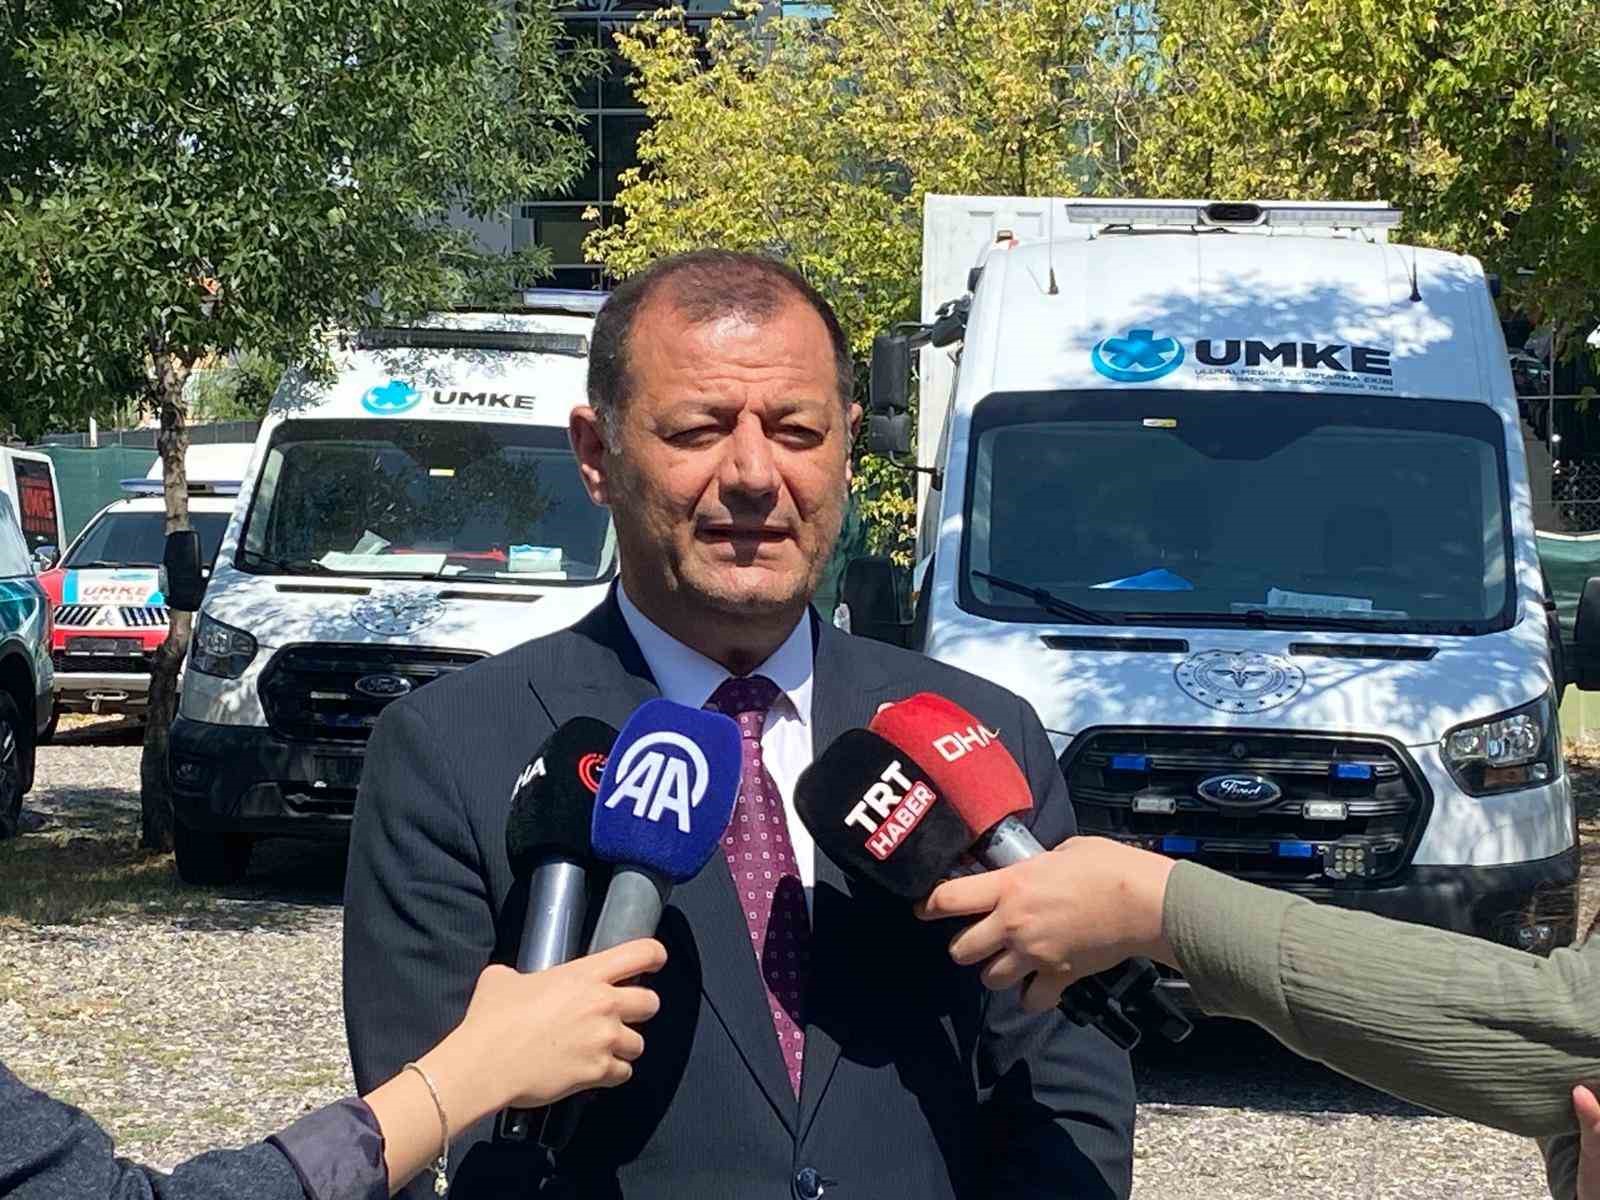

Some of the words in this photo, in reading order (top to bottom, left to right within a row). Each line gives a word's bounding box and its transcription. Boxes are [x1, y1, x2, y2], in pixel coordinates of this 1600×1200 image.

[1195, 339, 1393, 377] UMKE
[433, 390, 537, 410] UMKE
[604, 751, 691, 834] AA
[844, 760, 912, 834] TRT
[870, 785, 931, 857] HABER
